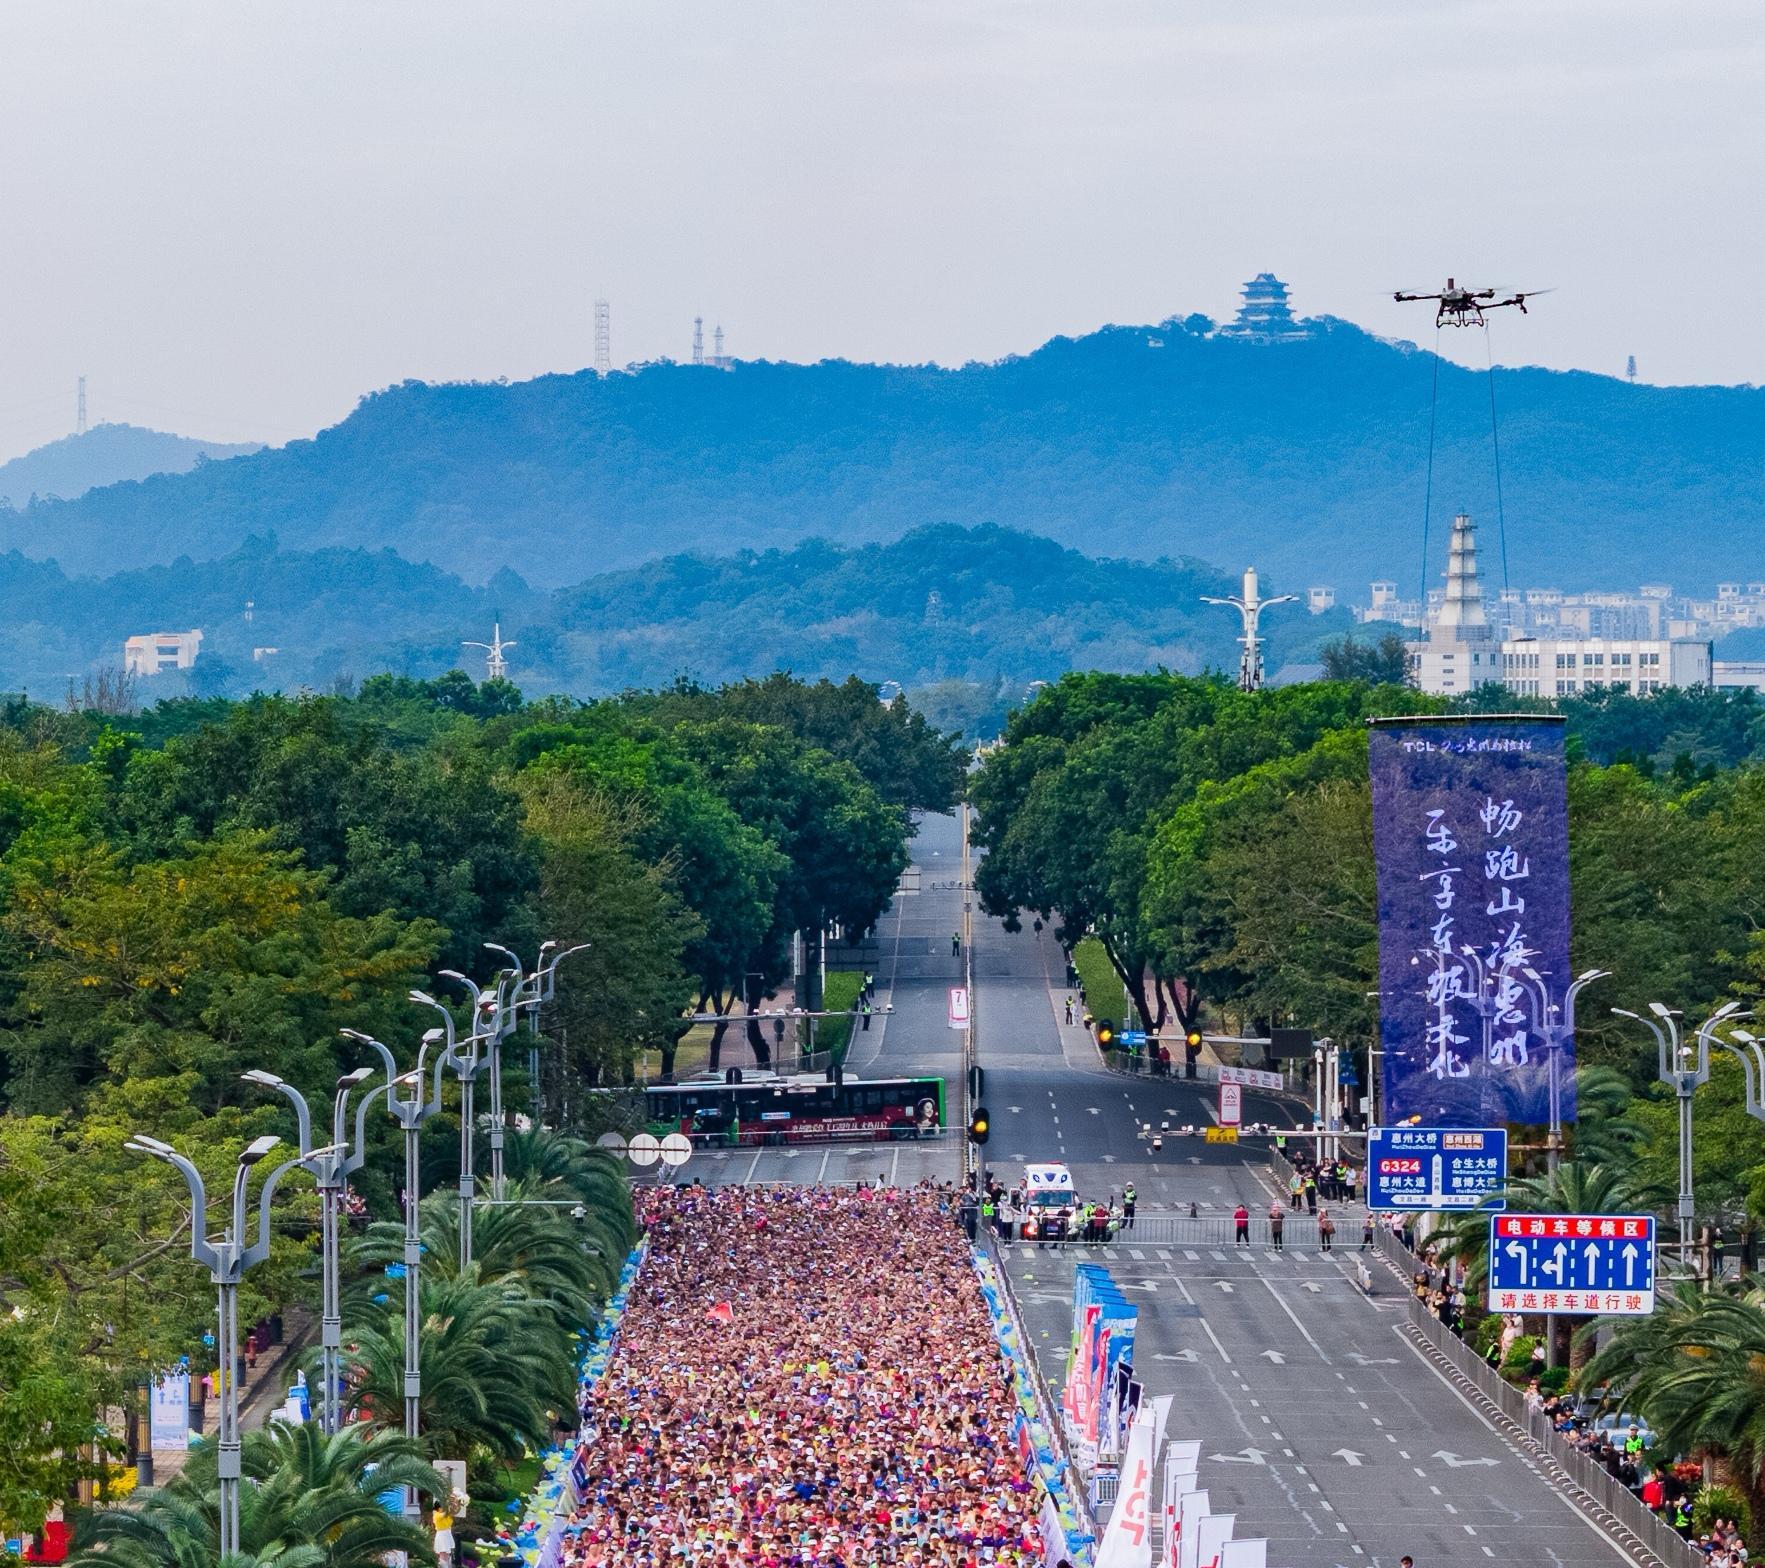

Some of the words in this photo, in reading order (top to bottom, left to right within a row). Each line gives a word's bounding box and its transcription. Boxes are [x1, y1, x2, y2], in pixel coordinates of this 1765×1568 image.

[1403, 741, 1435, 753] TCL
[1391, 1132, 1438, 1144] 惠州大桥
[1381, 1160, 1421, 1173] G324
[1452, 1157, 1498, 1169] 合生大桥
[1379, 1176, 1426, 1188] 惠州大道
[1507, 1219, 1638, 1236] 电动车等候区
[1501, 1293, 1642, 1310] 请选择车道行驶
[1120, 1459, 1149, 1546] TCL
